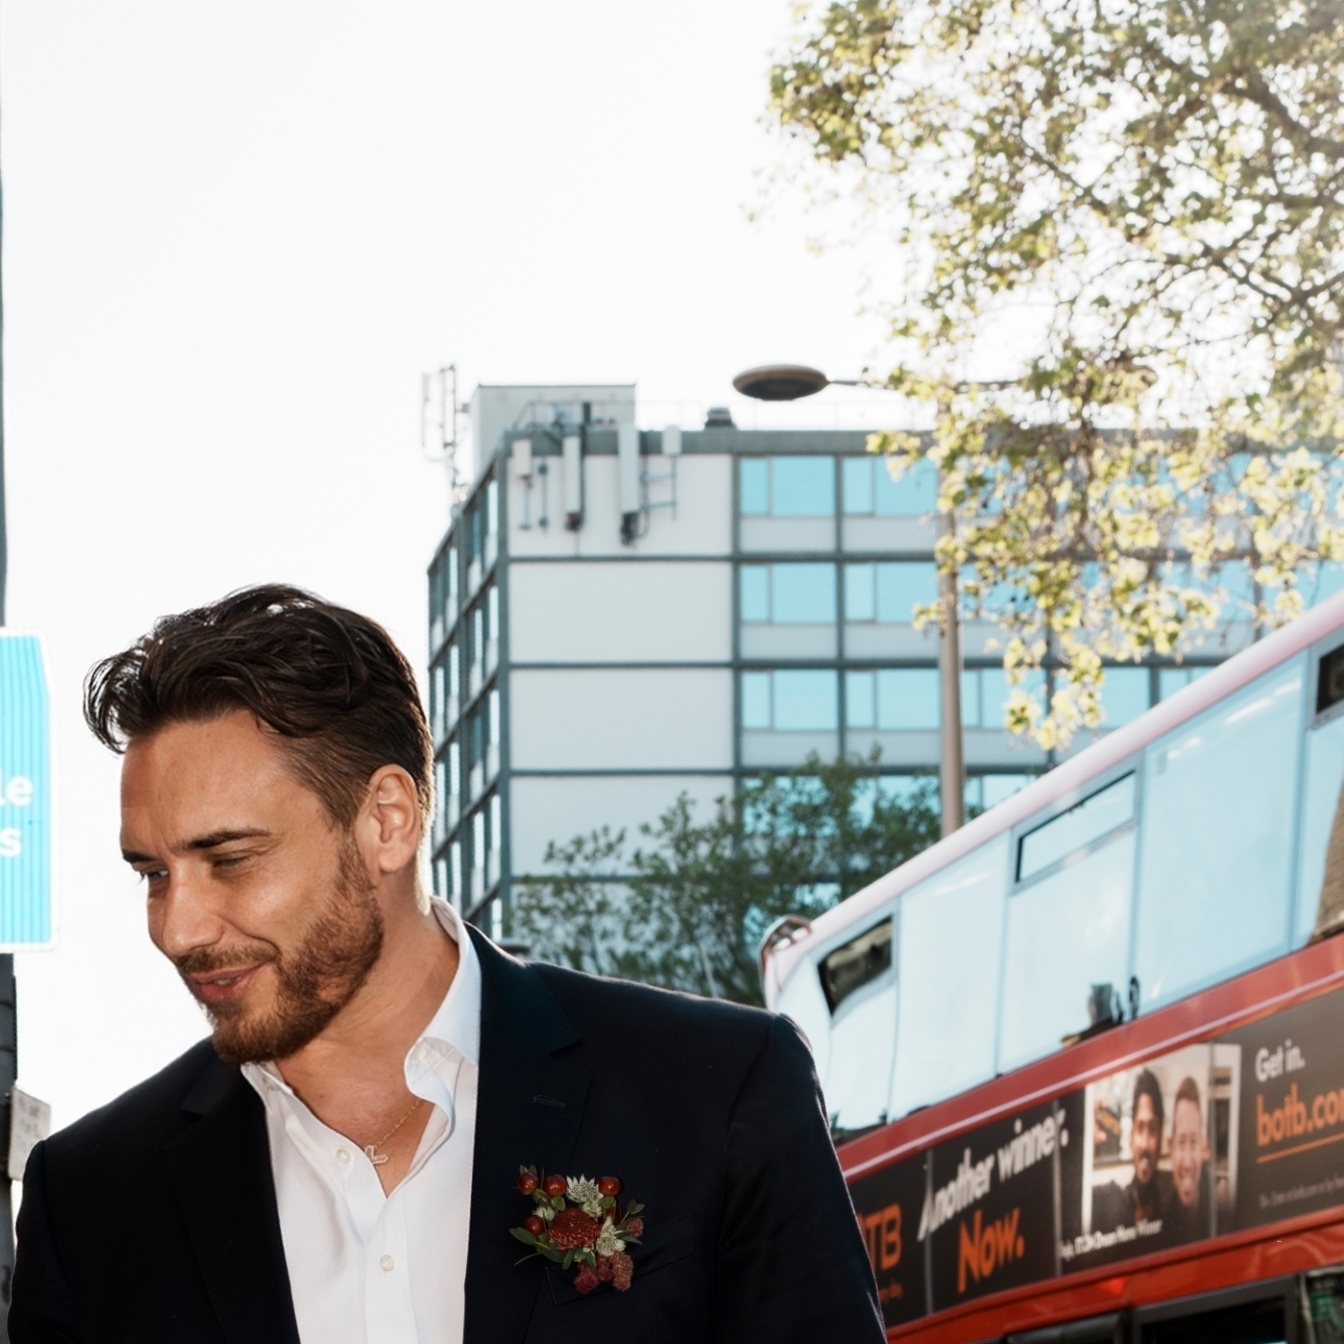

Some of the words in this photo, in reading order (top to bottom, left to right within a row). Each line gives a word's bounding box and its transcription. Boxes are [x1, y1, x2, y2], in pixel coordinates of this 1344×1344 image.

[1256, 1046, 1283, 1083] Get
[1285, 1038, 1305, 1073] in.
[1257, 1082, 1344, 1147] botb.co
[917, 1148, 995, 1241] Another
[957, 1207, 1025, 1294] Now.
